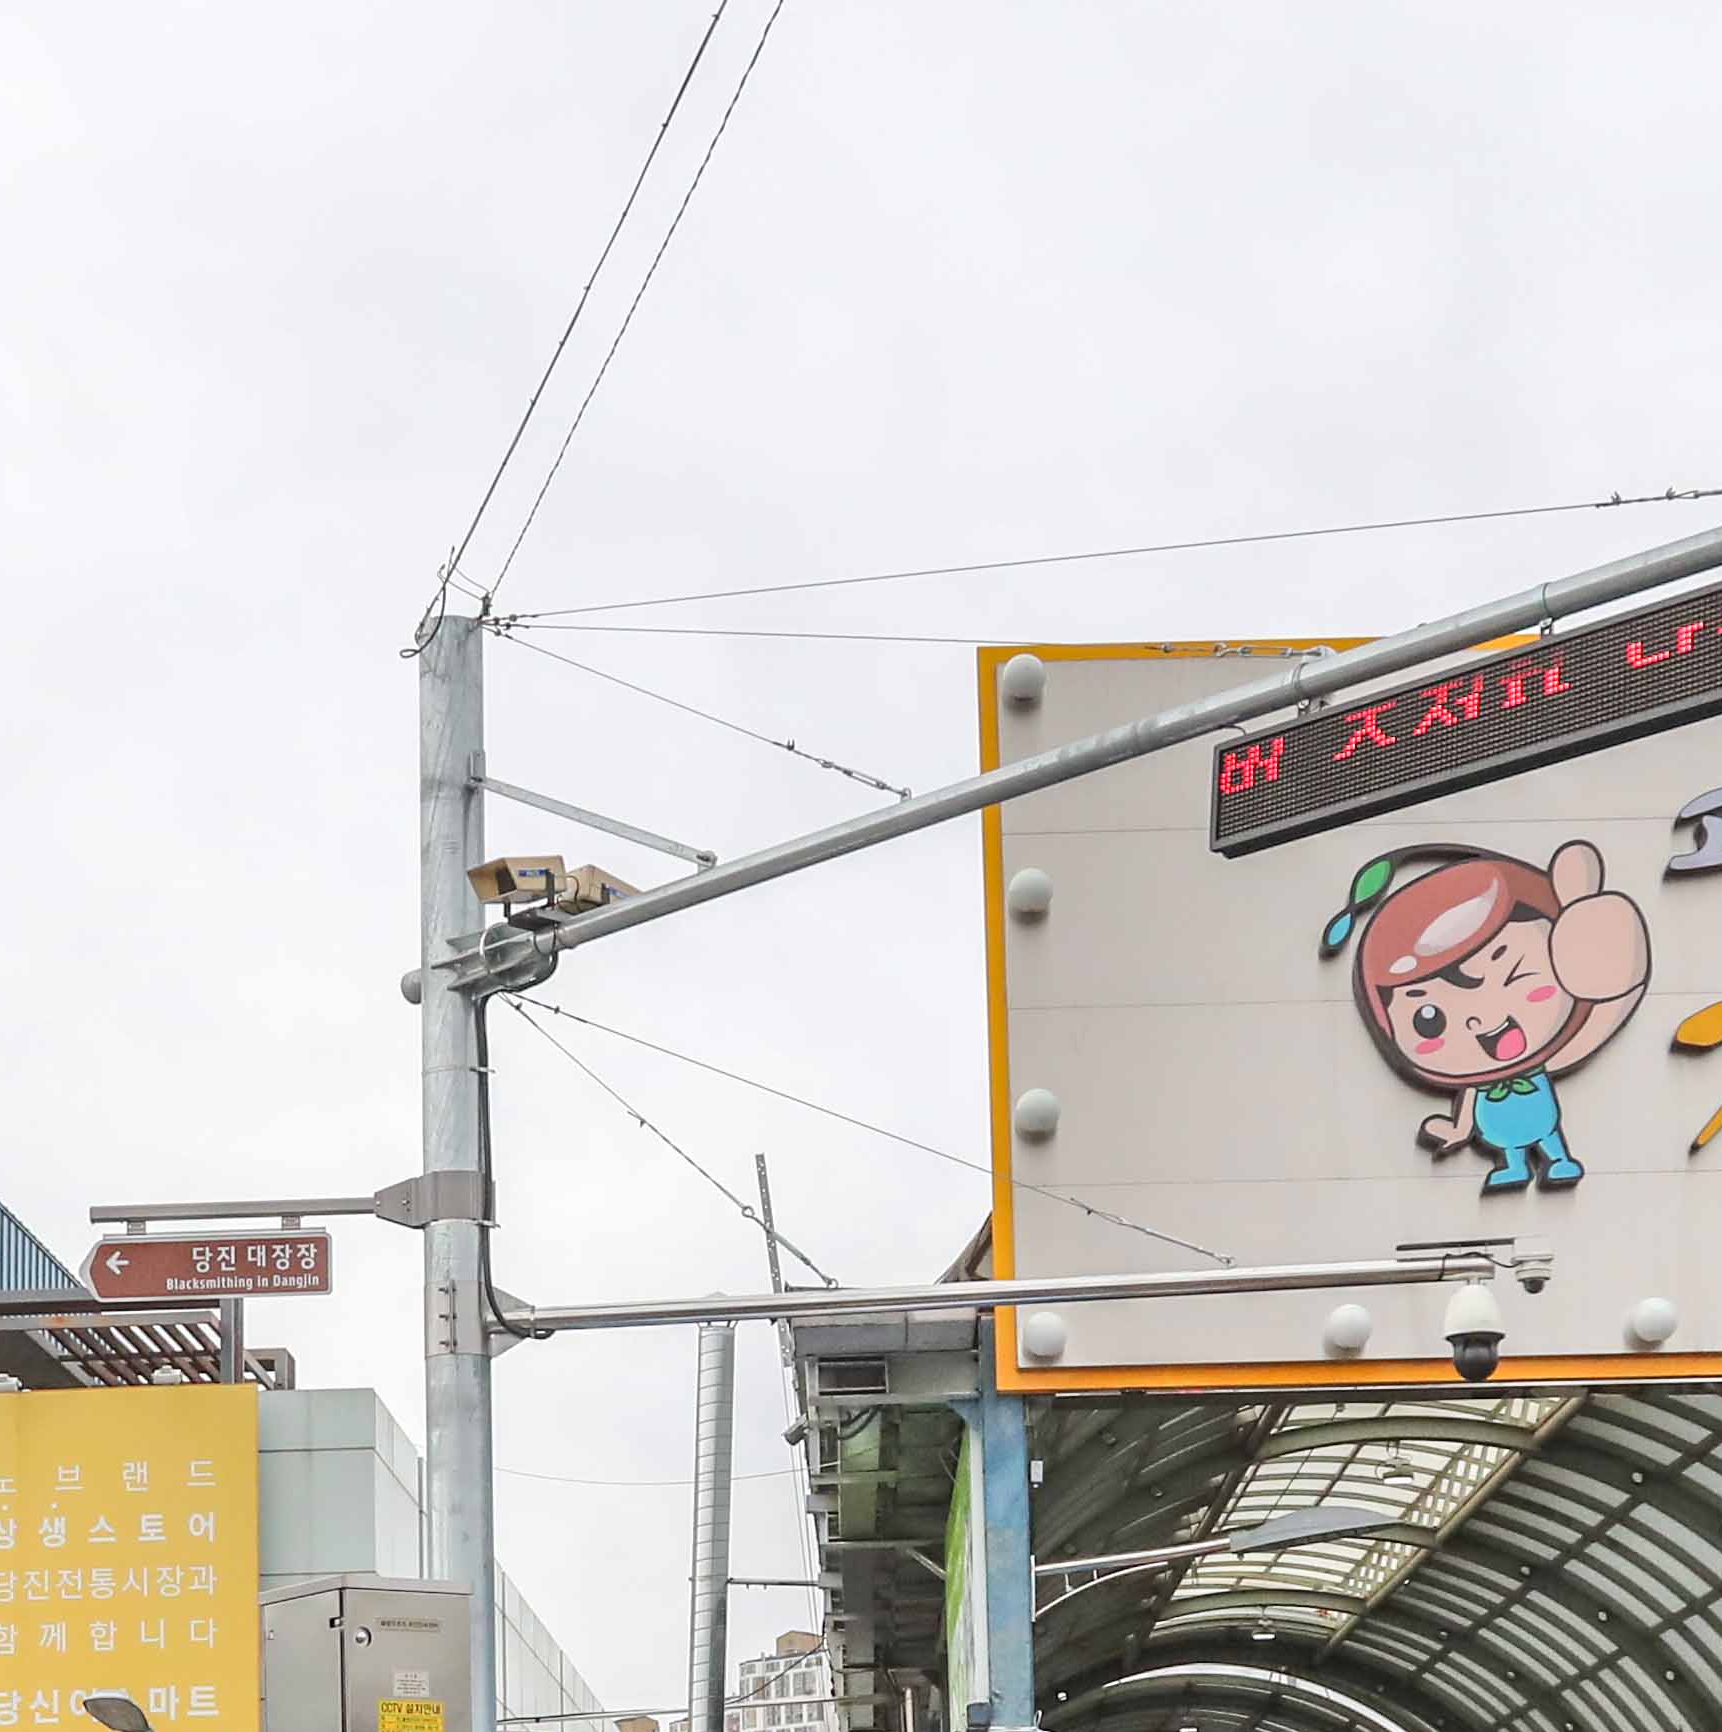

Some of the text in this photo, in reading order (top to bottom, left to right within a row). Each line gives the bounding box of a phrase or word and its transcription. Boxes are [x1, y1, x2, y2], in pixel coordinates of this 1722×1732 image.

[191, 1243, 318, 1274] 당진 대장장
[166, 1272, 319, 1292] Blacksmithing in Dangjin
[381, 1702, 404, 1714] CCTV
